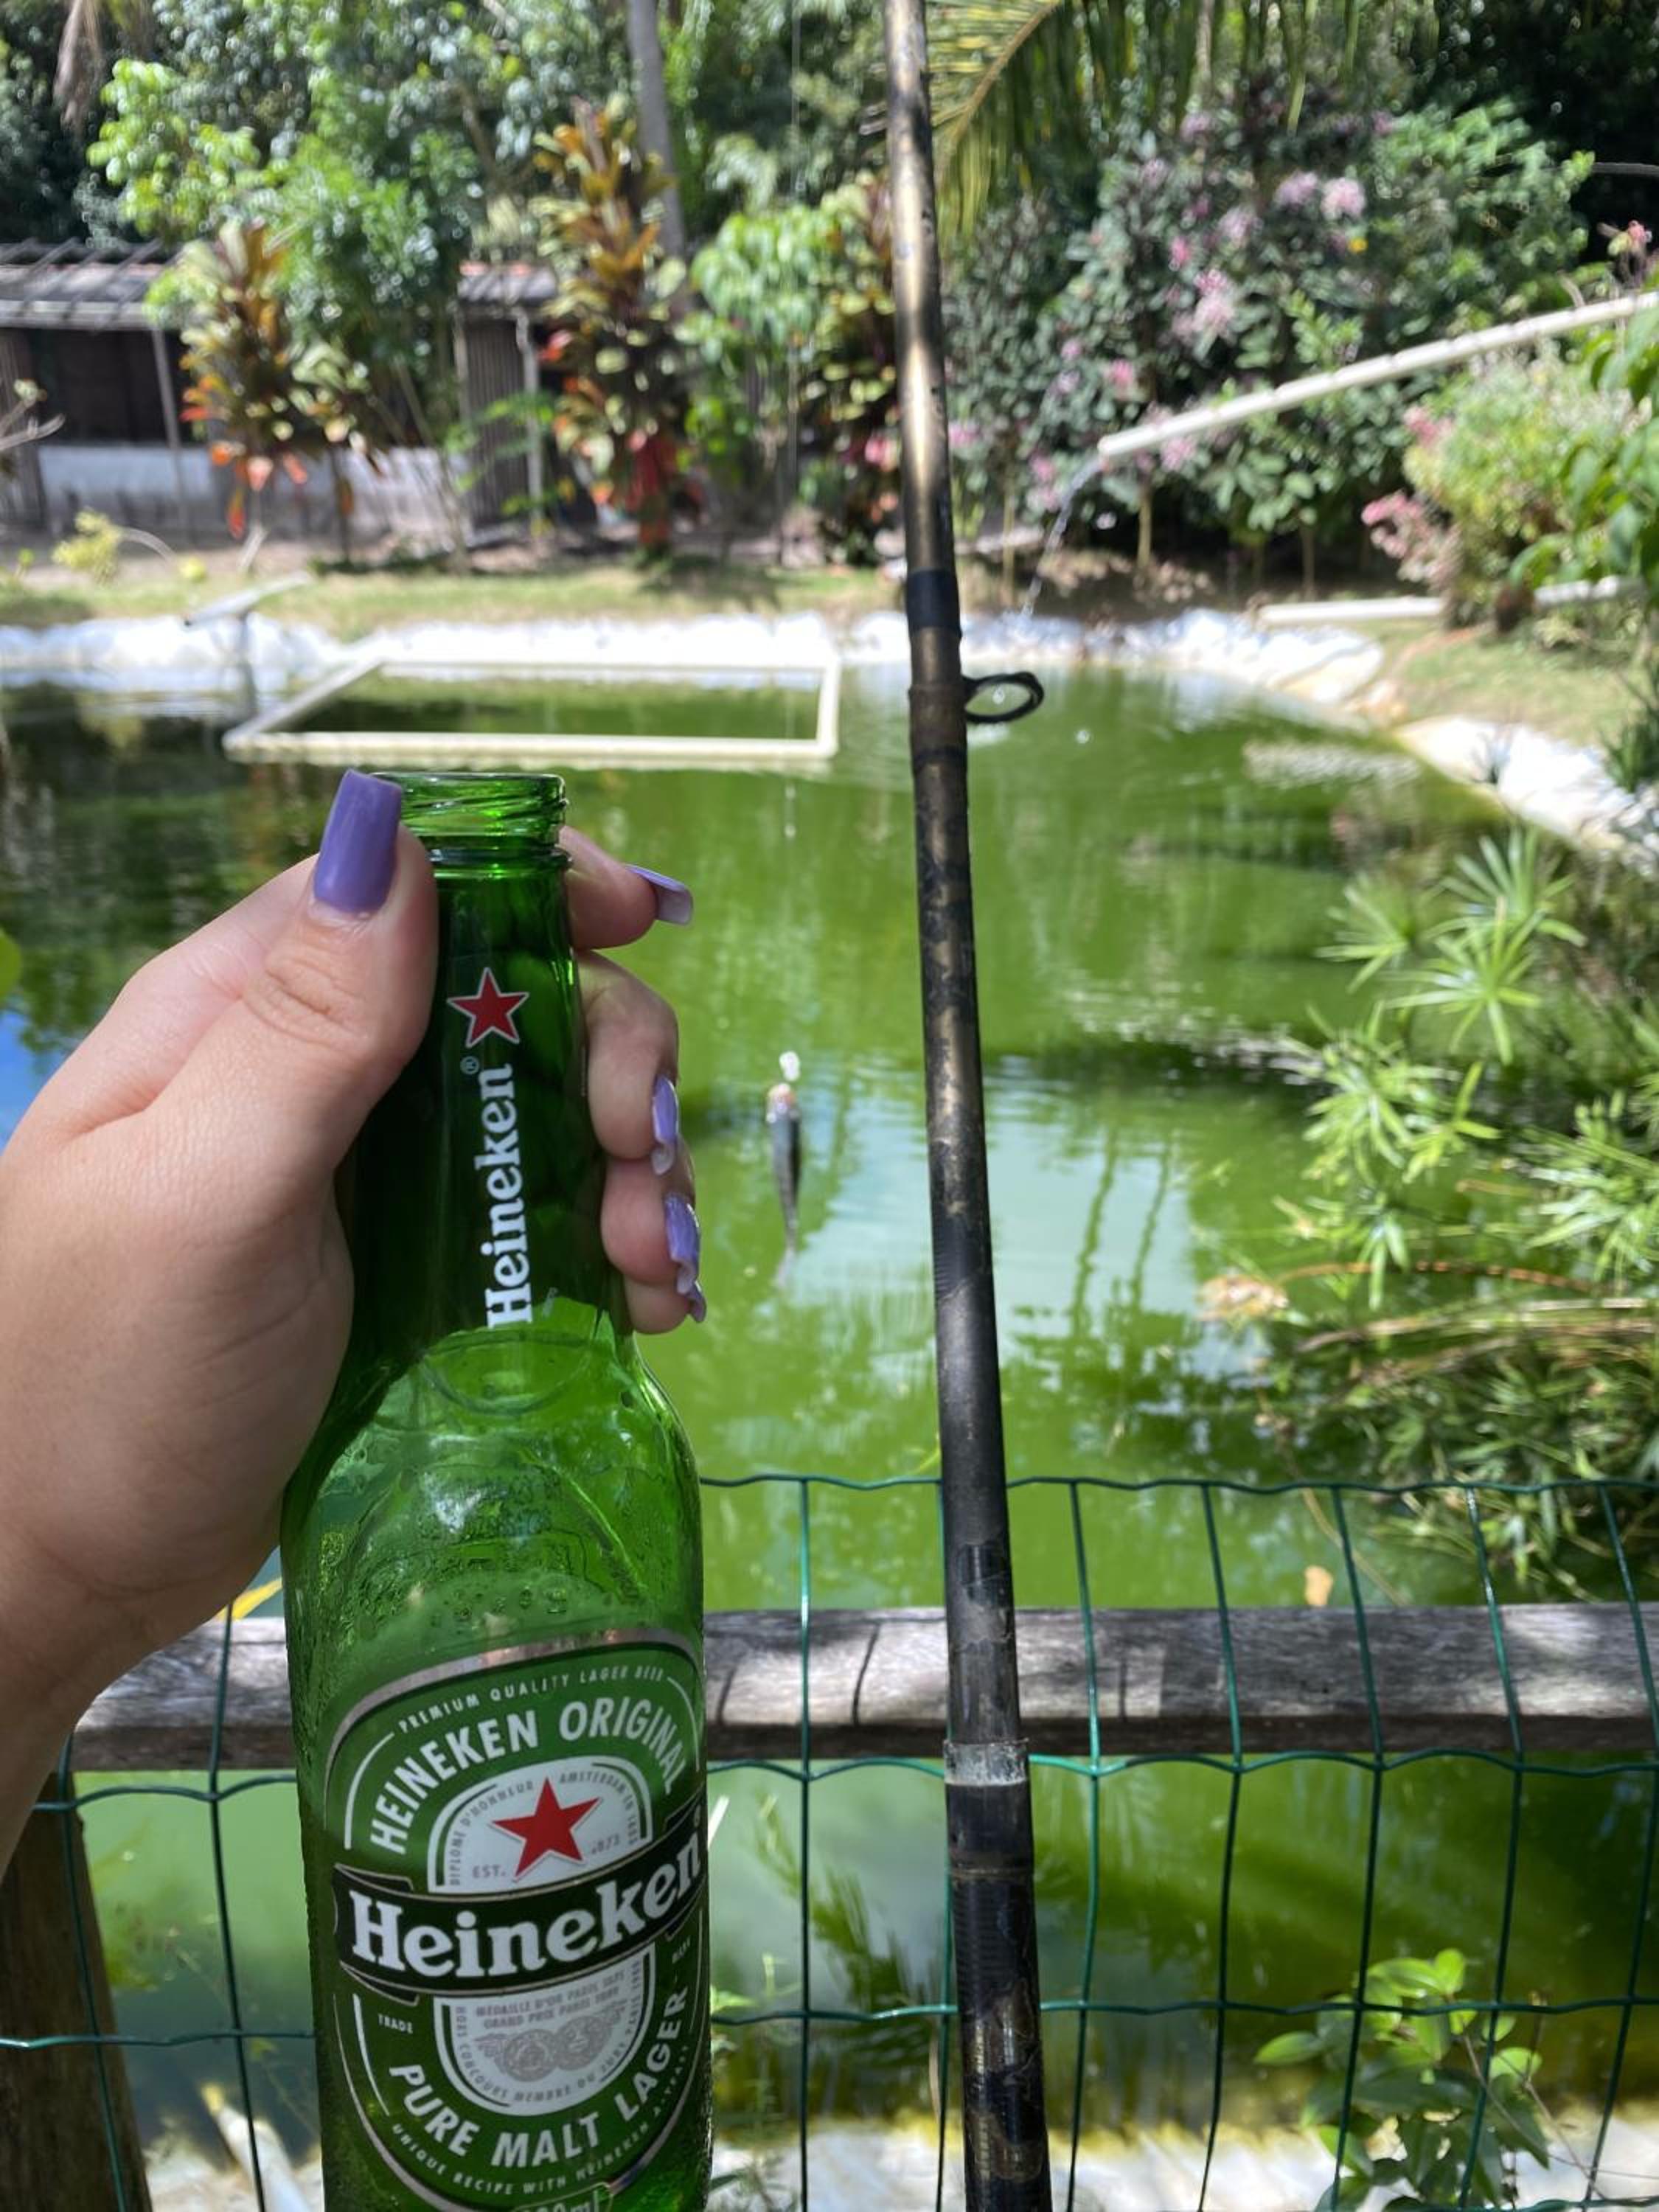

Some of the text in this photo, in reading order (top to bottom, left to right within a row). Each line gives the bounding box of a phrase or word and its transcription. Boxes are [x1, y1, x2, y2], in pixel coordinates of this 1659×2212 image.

[476, 1062, 533, 1329] Heineken
[370, 1696, 686, 1854] HEINEKEN ORIGINAL
[398, 1694, 479, 1733] PREMIUM
[490, 1673, 569, 1701] QUALITY
[349, 1831, 701, 1978] Heineken
[473, 1864, 507, 1878] EST.
[389, 1987, 688, 2168] PURE MALT LAGER
[392, 2124, 447, 2175] UNIQUE
[453, 2172, 514, 2194] RECIPE
[523, 2176, 566, 2194] WITH
